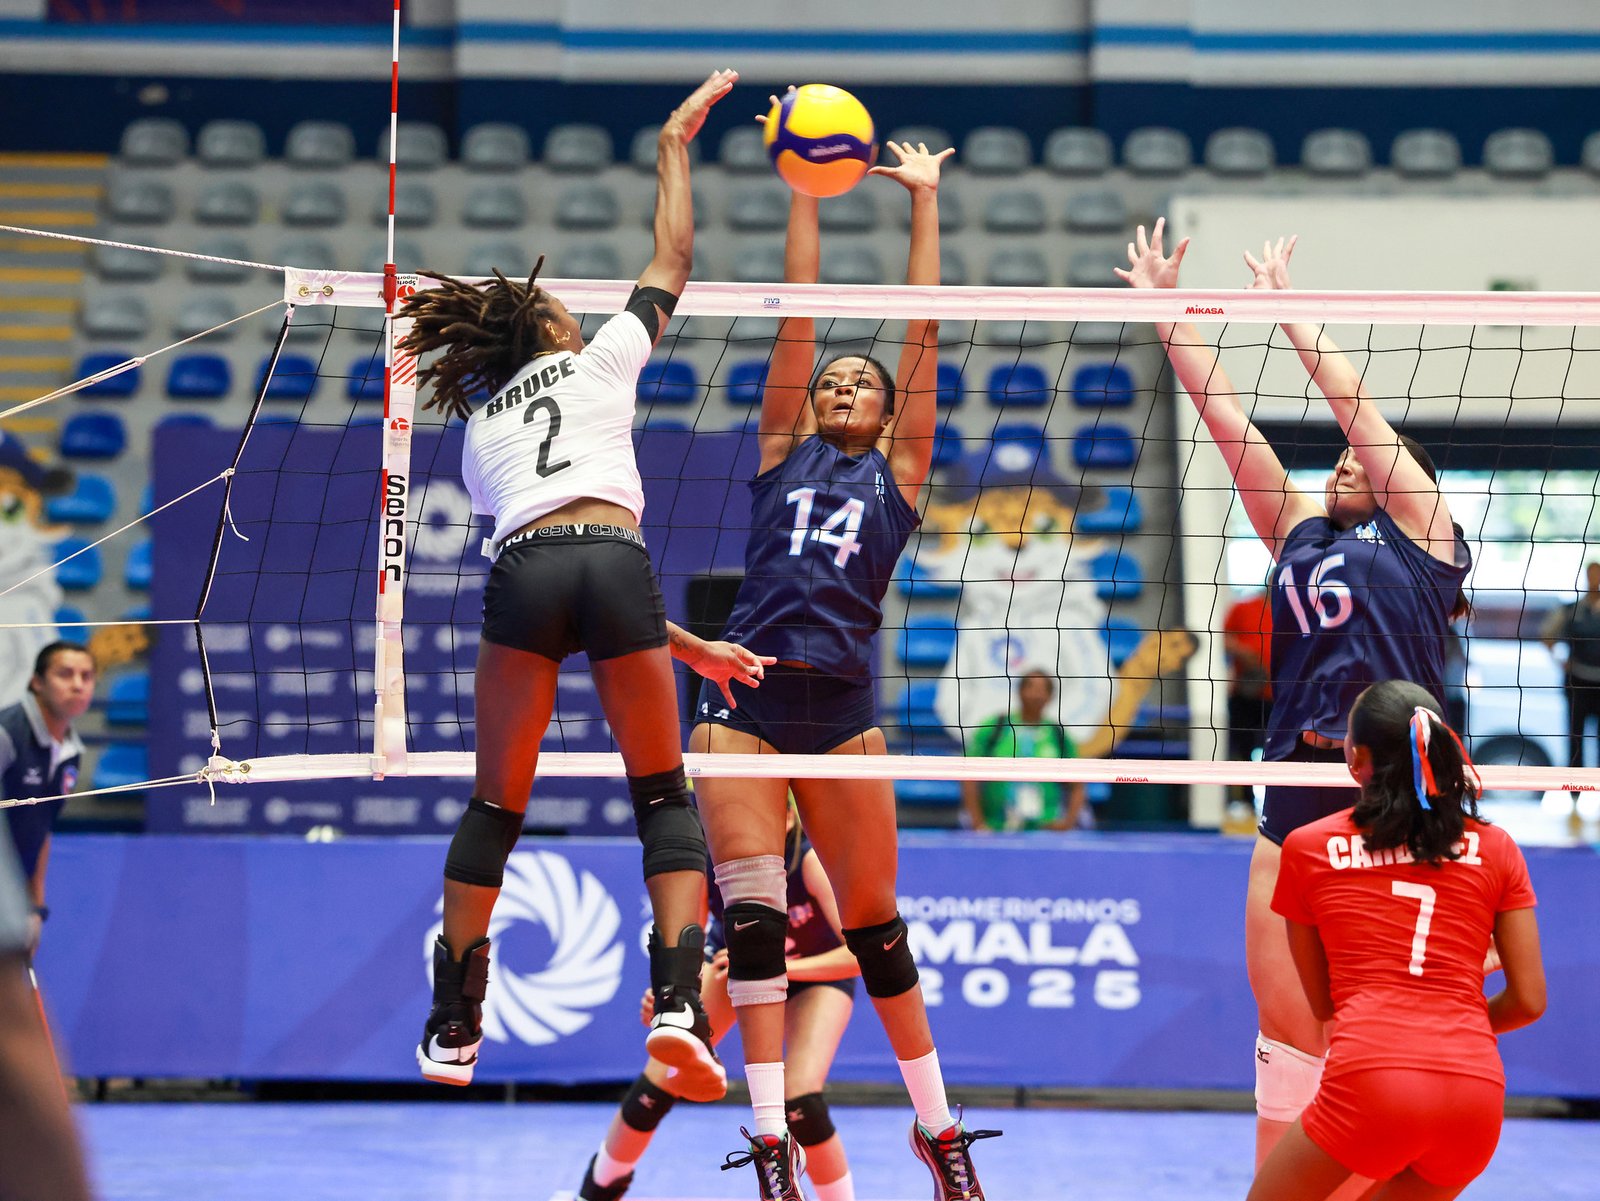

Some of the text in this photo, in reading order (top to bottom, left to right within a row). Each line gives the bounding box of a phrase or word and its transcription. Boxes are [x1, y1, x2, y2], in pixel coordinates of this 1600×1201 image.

[486, 357, 576, 419] BRUCE
[523, 396, 572, 478] 2
[786, 487, 865, 569] 14
[1278, 553, 1354, 639] 16
[896, 896, 1141, 925] ROAMERICANOS
[905, 920, 1140, 967] MALA
[1391, 880, 1437, 977] 7
